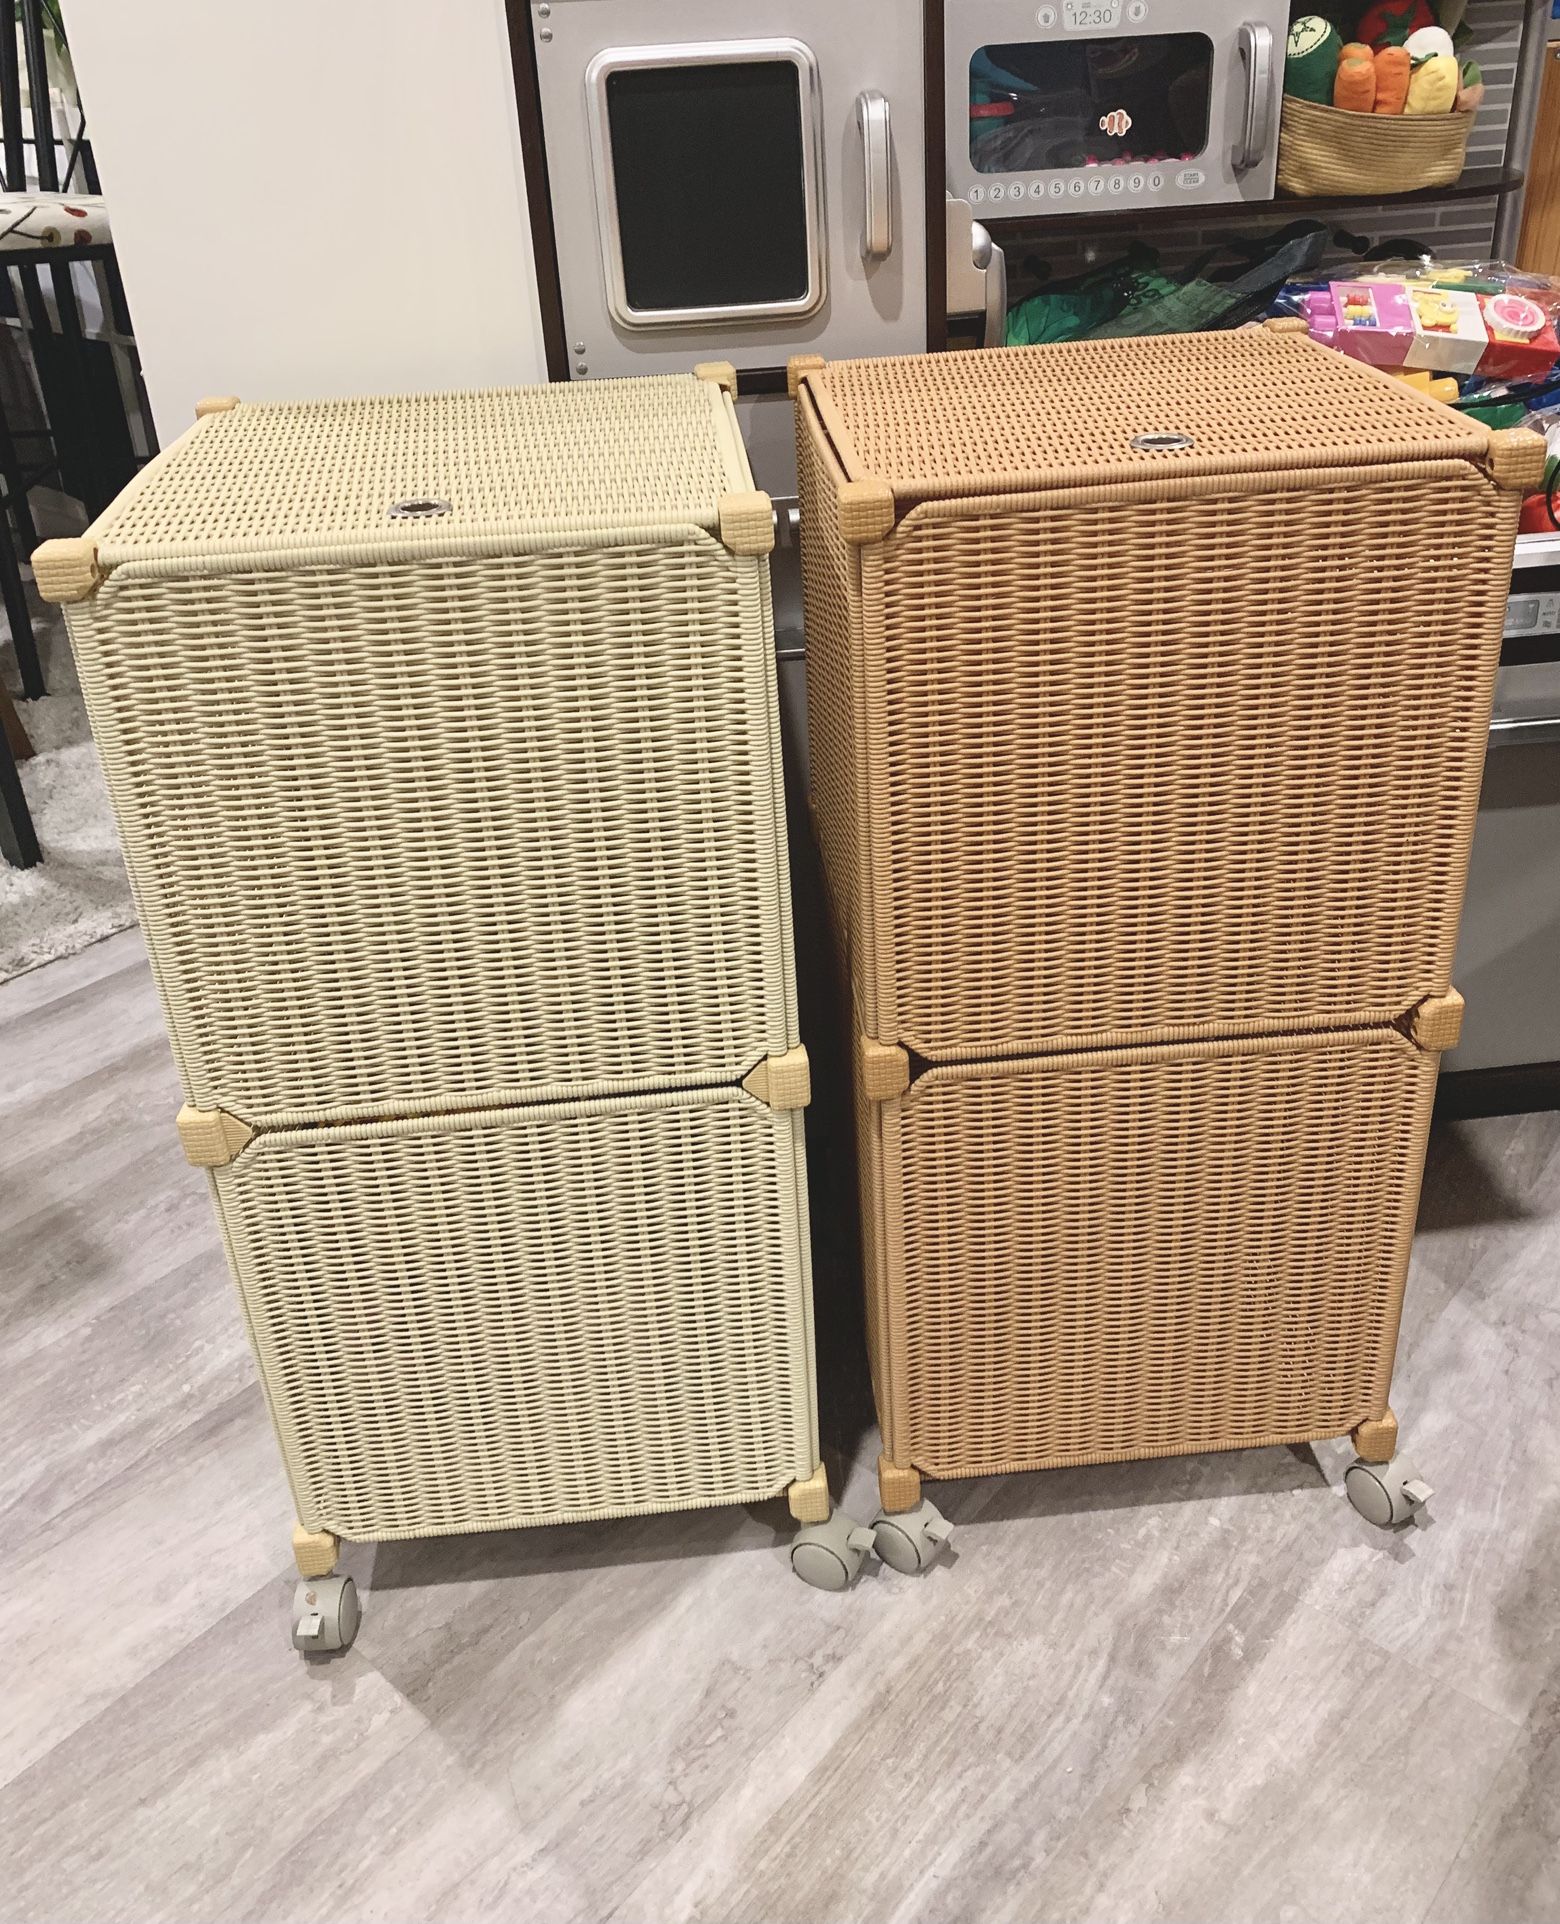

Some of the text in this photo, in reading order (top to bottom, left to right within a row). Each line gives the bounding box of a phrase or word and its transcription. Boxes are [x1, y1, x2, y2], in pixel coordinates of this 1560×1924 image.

[1072, 9, 1112, 25] 12:30
[993, 187, 1001, 199] 2
[1013, 186, 1021, 197] 3
[1033, 184, 1041, 195] 4
[1054, 183, 1061, 194] 5
[1073, 181, 1081, 193] 6
[1094, 180, 1101, 191] 7
[1113, 178, 1121, 190] 8
[1133, 177, 1141, 188] 9
[1153, 175, 1161, 187] 0
